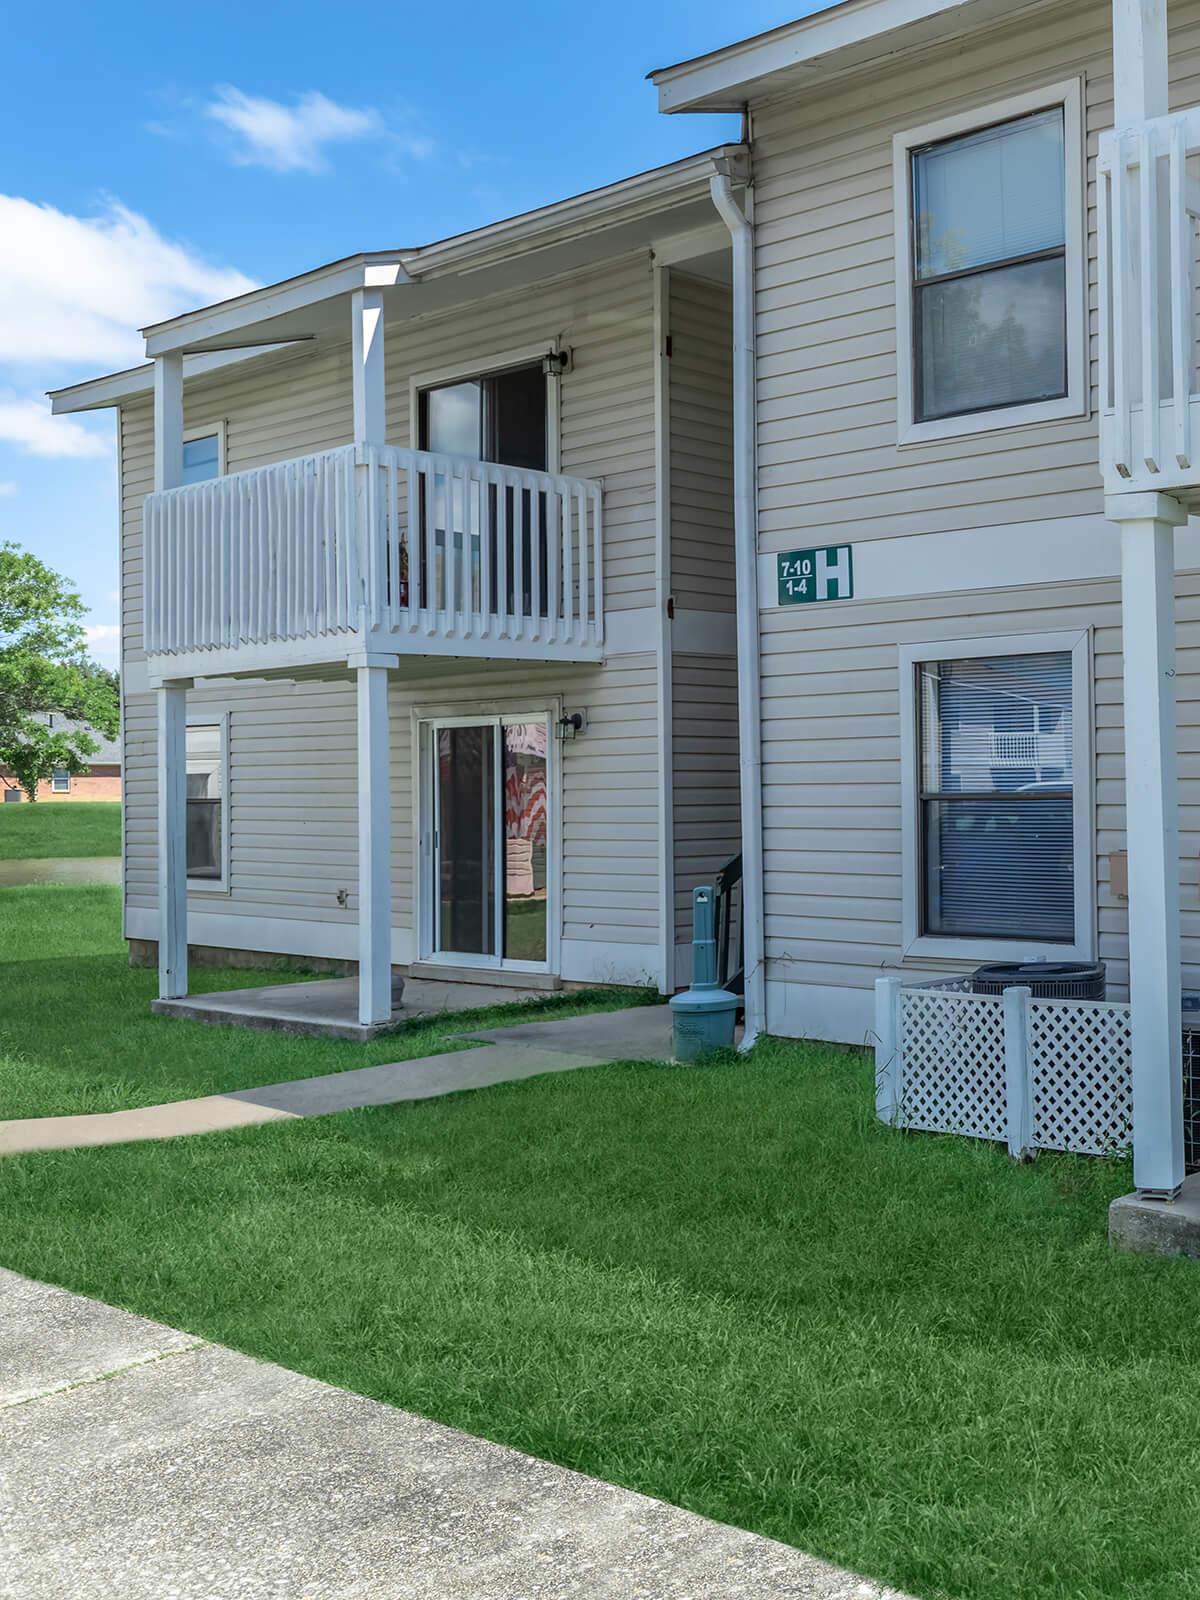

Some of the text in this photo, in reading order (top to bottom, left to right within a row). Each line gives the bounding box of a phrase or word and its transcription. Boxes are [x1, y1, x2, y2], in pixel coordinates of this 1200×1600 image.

[781, 559, 811, 577] 7-10
[815, 547, 850, 600] H
[786, 578, 807, 595] 1-4
